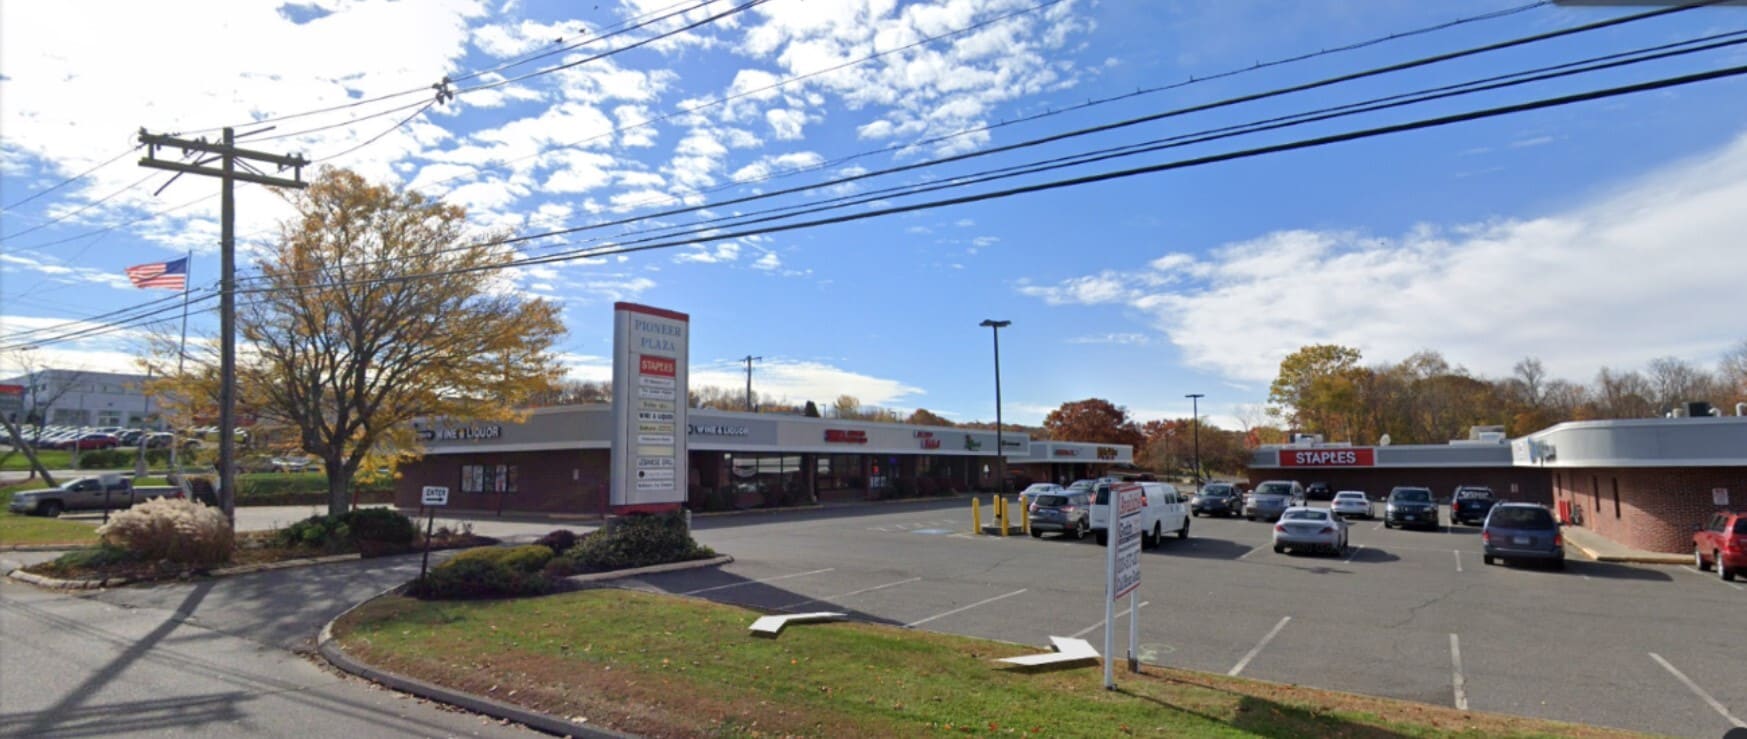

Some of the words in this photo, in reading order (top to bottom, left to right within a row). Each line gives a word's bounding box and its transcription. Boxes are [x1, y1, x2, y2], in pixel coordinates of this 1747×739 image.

[635, 320, 682, 337] PIONEER
[641, 336, 676, 352] PLAZA
[641, 359, 674, 373] STAPLES
[466, 426, 501, 439] LIQUOR
[1296, 451, 1357, 464] STAPLES
[425, 488, 446, 497] ENTER
